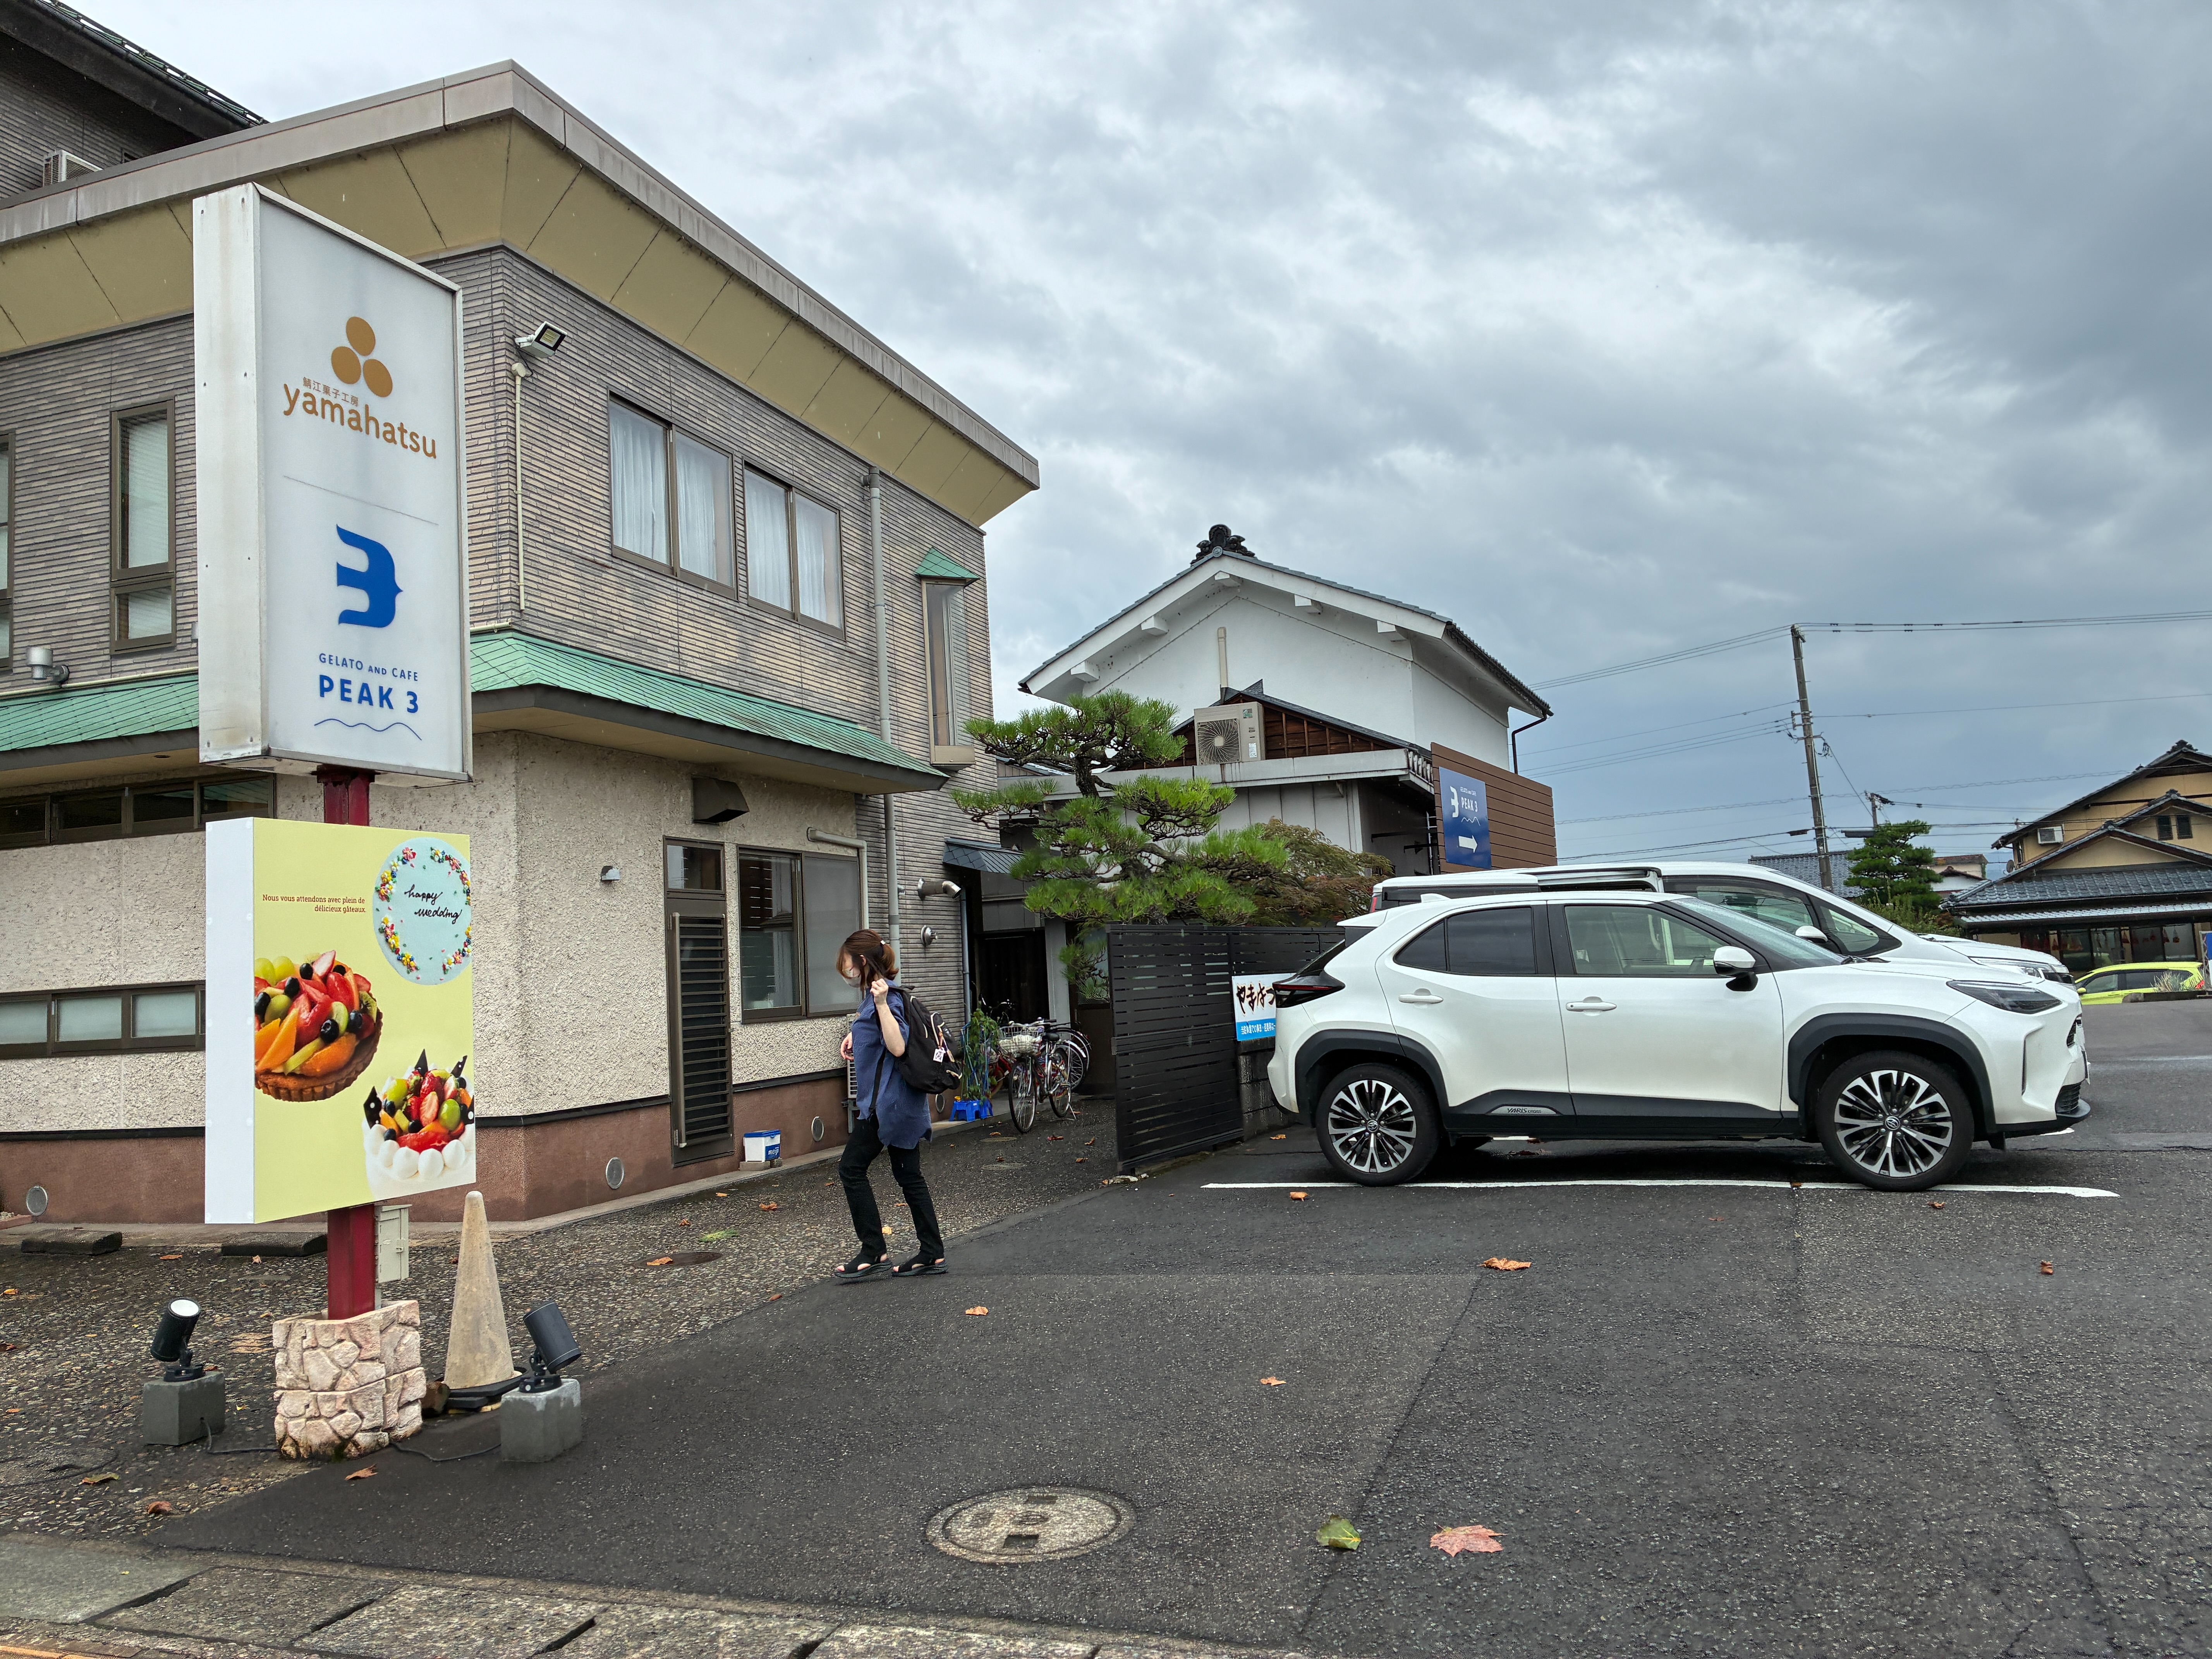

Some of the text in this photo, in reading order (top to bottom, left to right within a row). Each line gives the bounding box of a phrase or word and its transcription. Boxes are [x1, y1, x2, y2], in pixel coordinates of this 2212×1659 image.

[303, 377, 359, 407] 鯖江菓子工房
[283, 384, 437, 459] yamahatsu
[319, 653, 418, 681] GELATO AND CAFE
[319, 675, 418, 713] PEAK 3
[1461, 797, 1478, 812] PEAK 3
[343, 896, 357, 904] plein
[404, 884, 443, 905] happy
[414, 906, 462, 925] wedding
